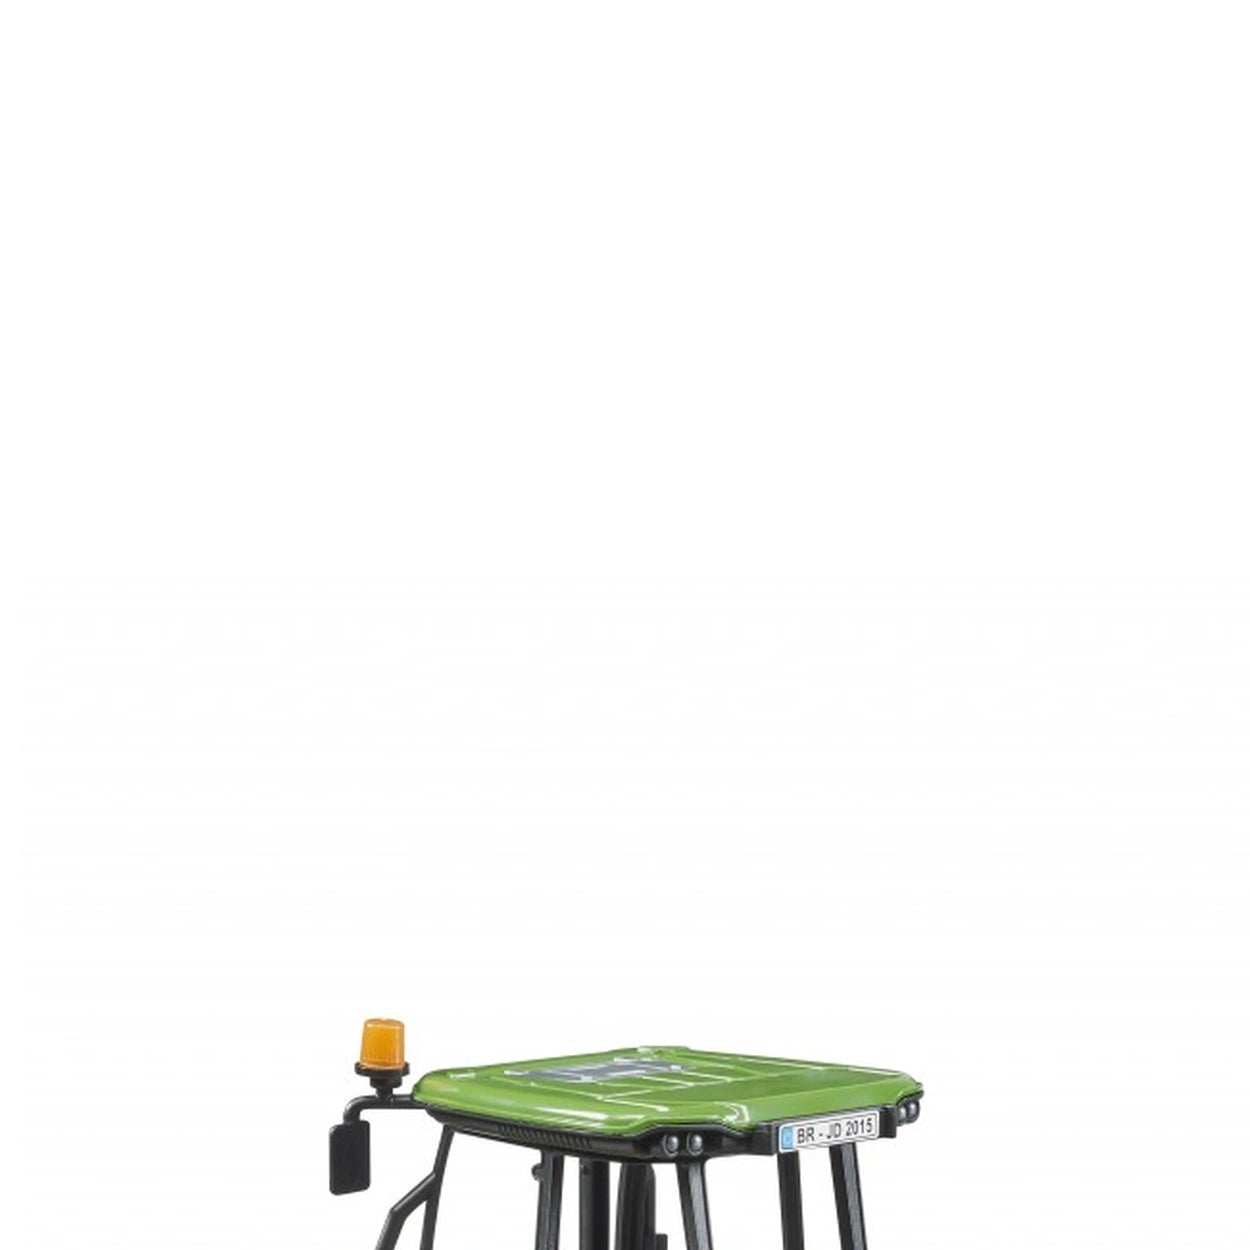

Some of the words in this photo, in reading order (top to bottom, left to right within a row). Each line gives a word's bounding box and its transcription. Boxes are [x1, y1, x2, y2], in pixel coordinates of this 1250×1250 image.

[797, 1127, 815, 1144] BR
[826, 1122, 842, 1139] JD
[845, 1118, 873, 1136] 2015
